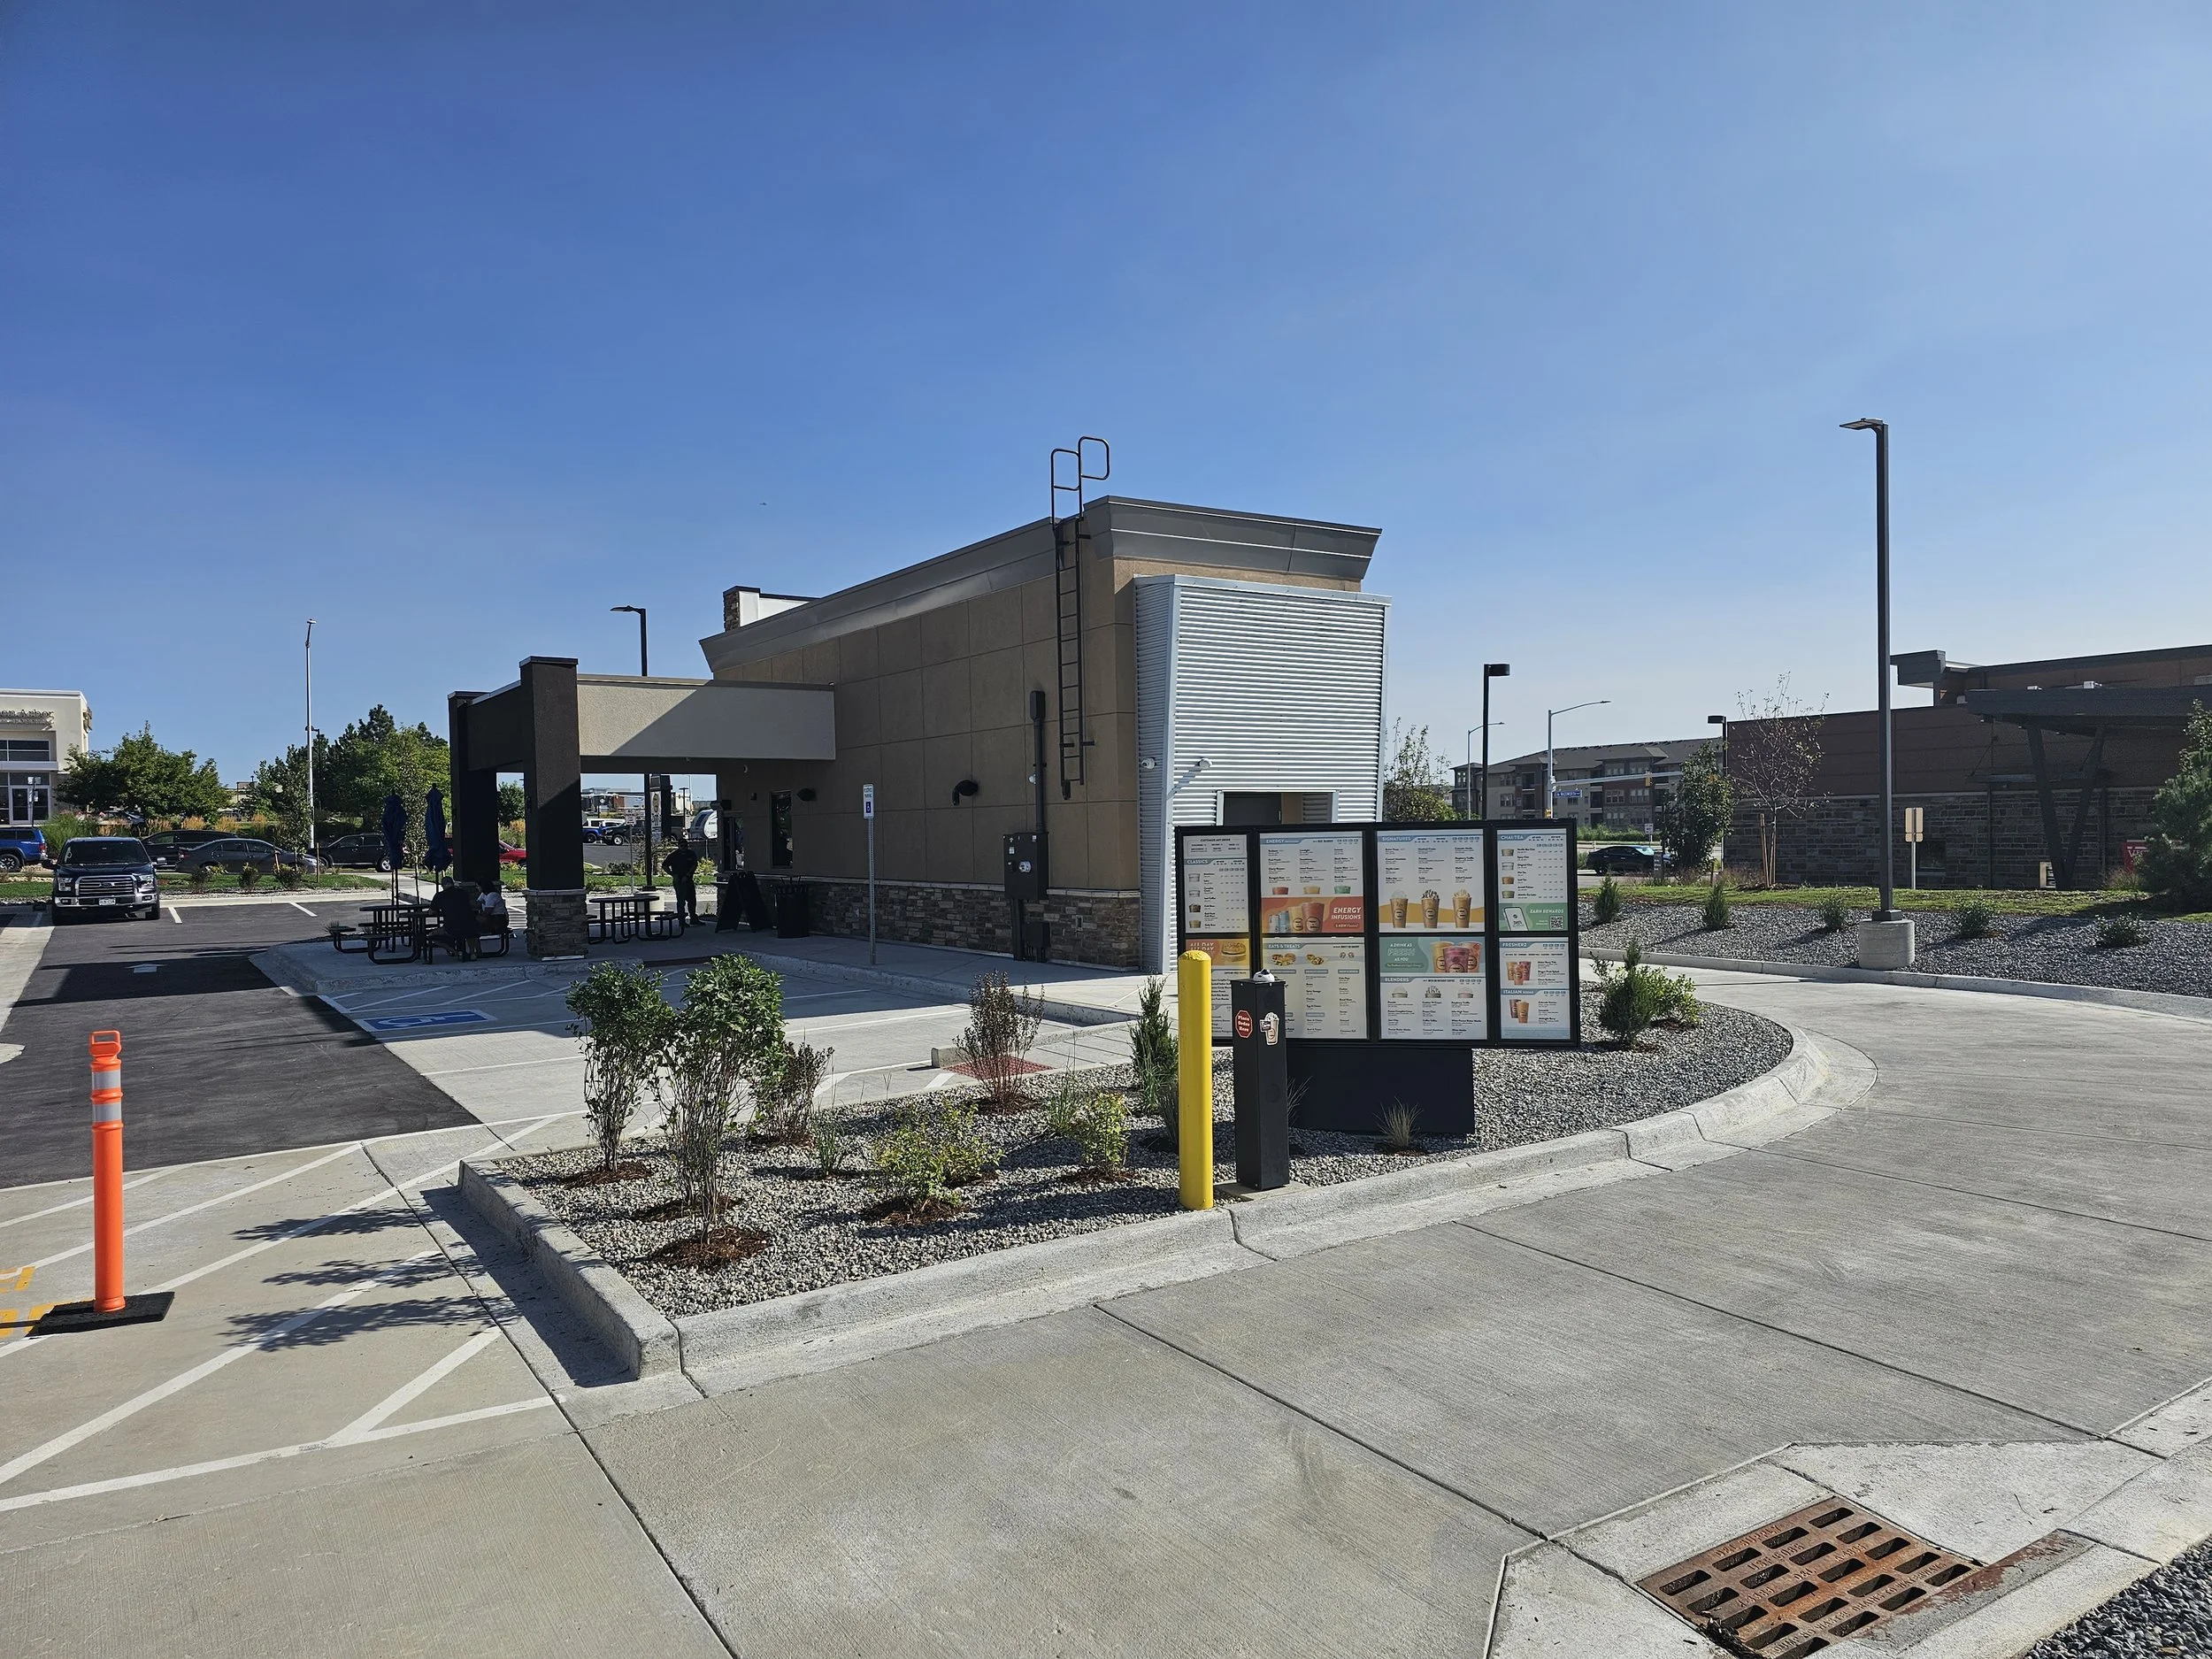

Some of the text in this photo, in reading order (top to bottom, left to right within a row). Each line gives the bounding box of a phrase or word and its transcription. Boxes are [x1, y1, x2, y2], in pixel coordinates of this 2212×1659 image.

[1740, 1525, 1781, 1547] SUPPLY
[1852, 1594, 1886, 1611] DRAINS
[1885, 1586, 1898, 1595] TO
[1896, 1563, 1947, 1589] WATERWAYS
